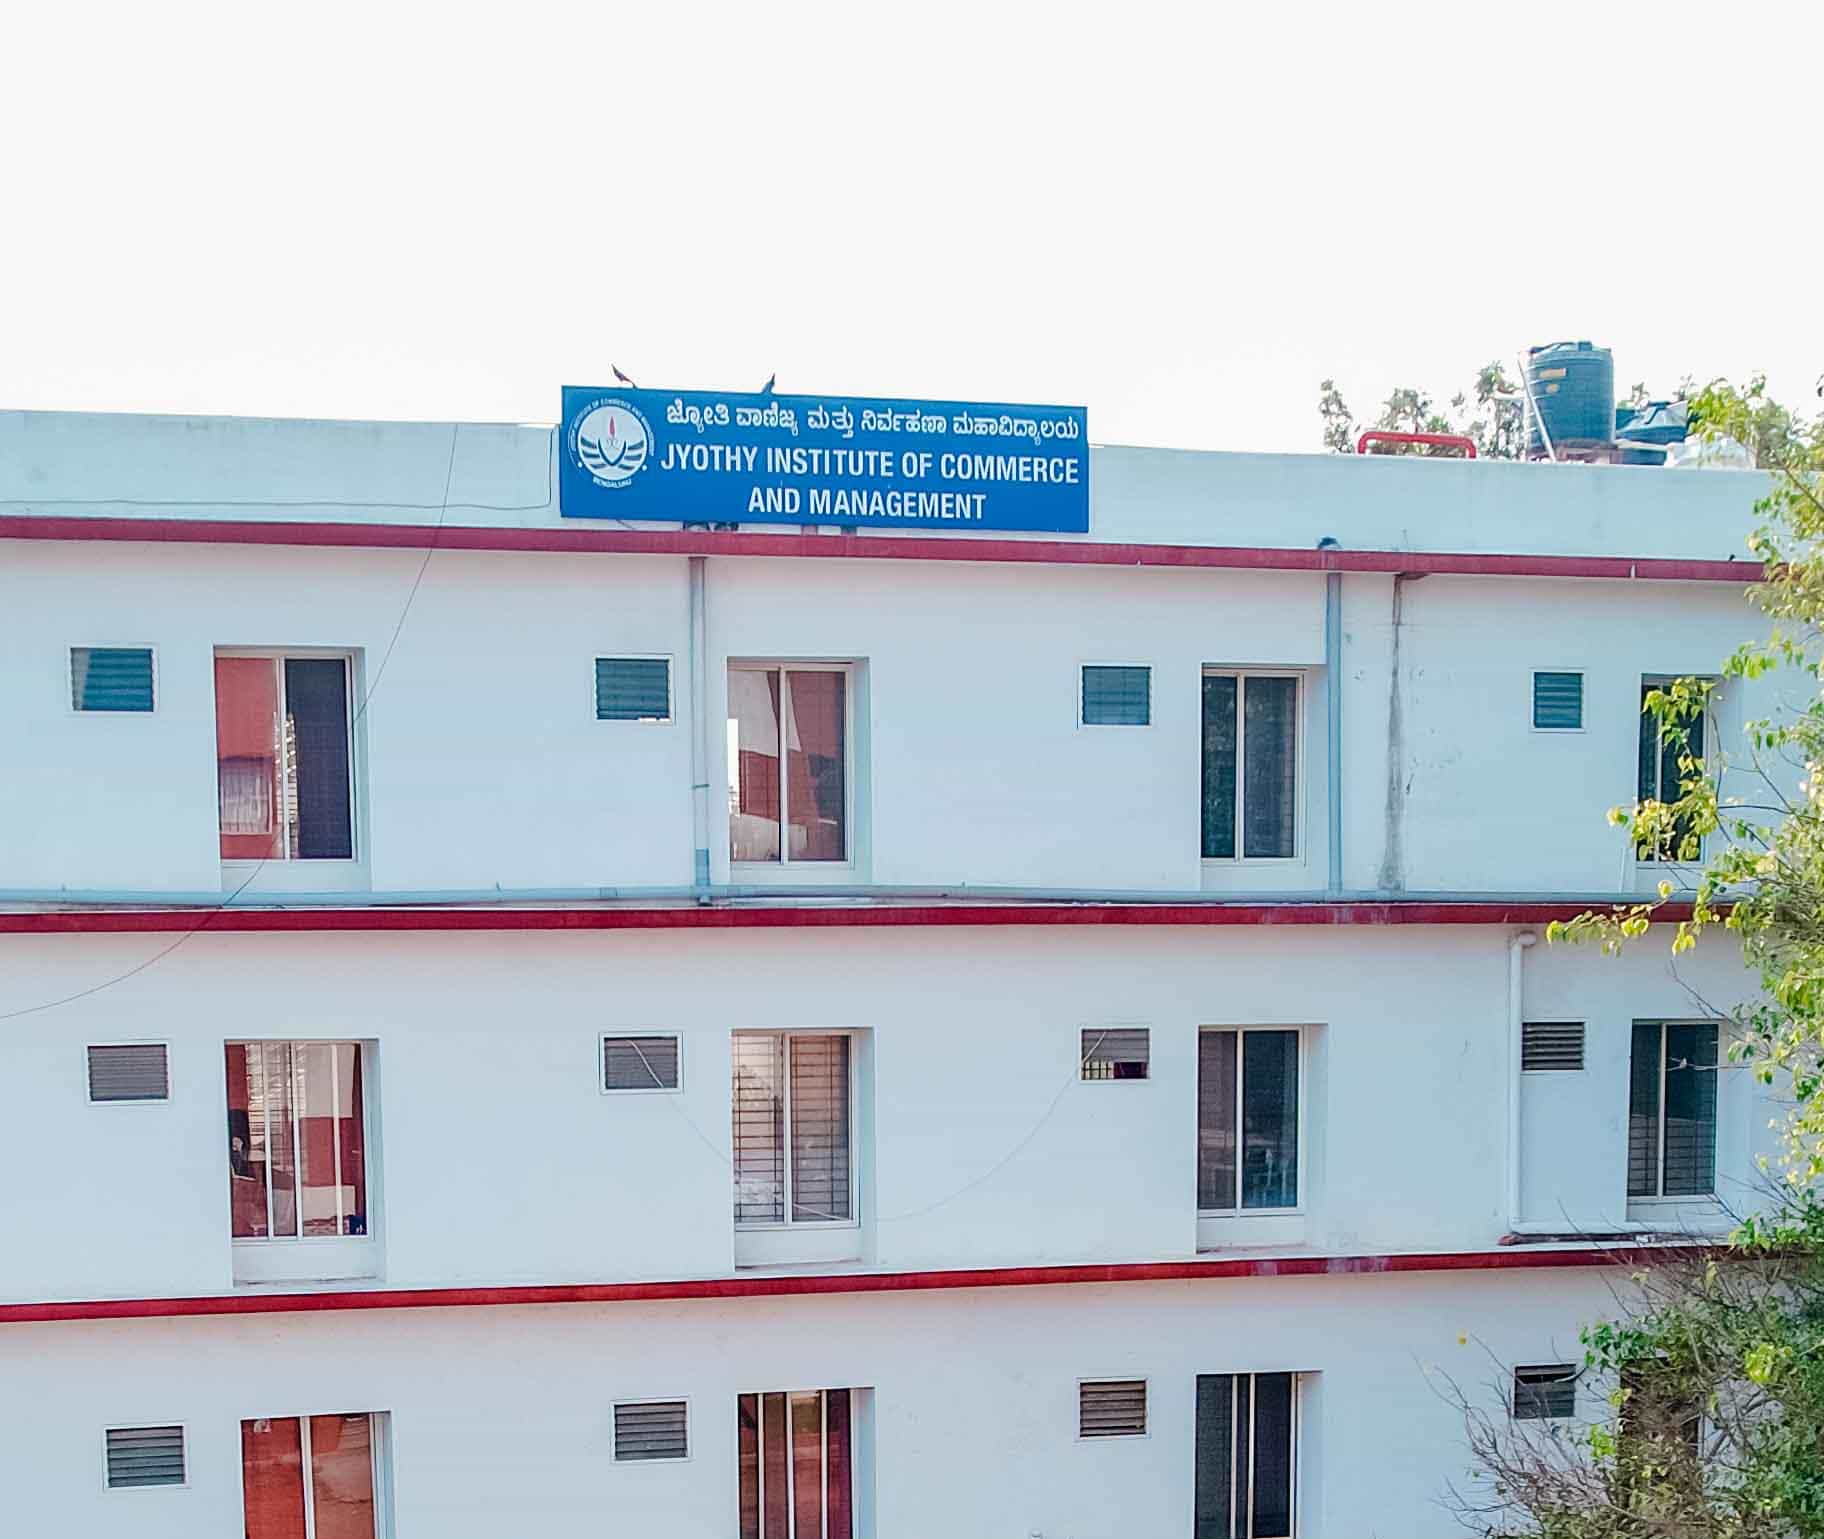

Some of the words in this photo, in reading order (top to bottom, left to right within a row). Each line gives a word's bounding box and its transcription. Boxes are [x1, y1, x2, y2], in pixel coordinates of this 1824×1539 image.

[666, 397, 730, 433] ಜ್ಯೋತಿ
[736, 401, 799, 436] ವಾಣಿಜ್ಯ
[807, 404, 854, 438] ಮತ್ತು
[861, 407, 947, 434] ನಿರ್ವಹಣಾ
[953, 411, 1079, 446] ಮಹಾವಿದ್ಯಾಲಯ
[660, 443, 758, 472] JYOTHY
[767, 447, 894, 477] INSTITUTE
[902, 451, 933, 478] OF
[940, 453, 1079, 484] COMMERCE
[748, 486, 800, 514] AND
[809, 488, 987, 520] MANAGEMENT
